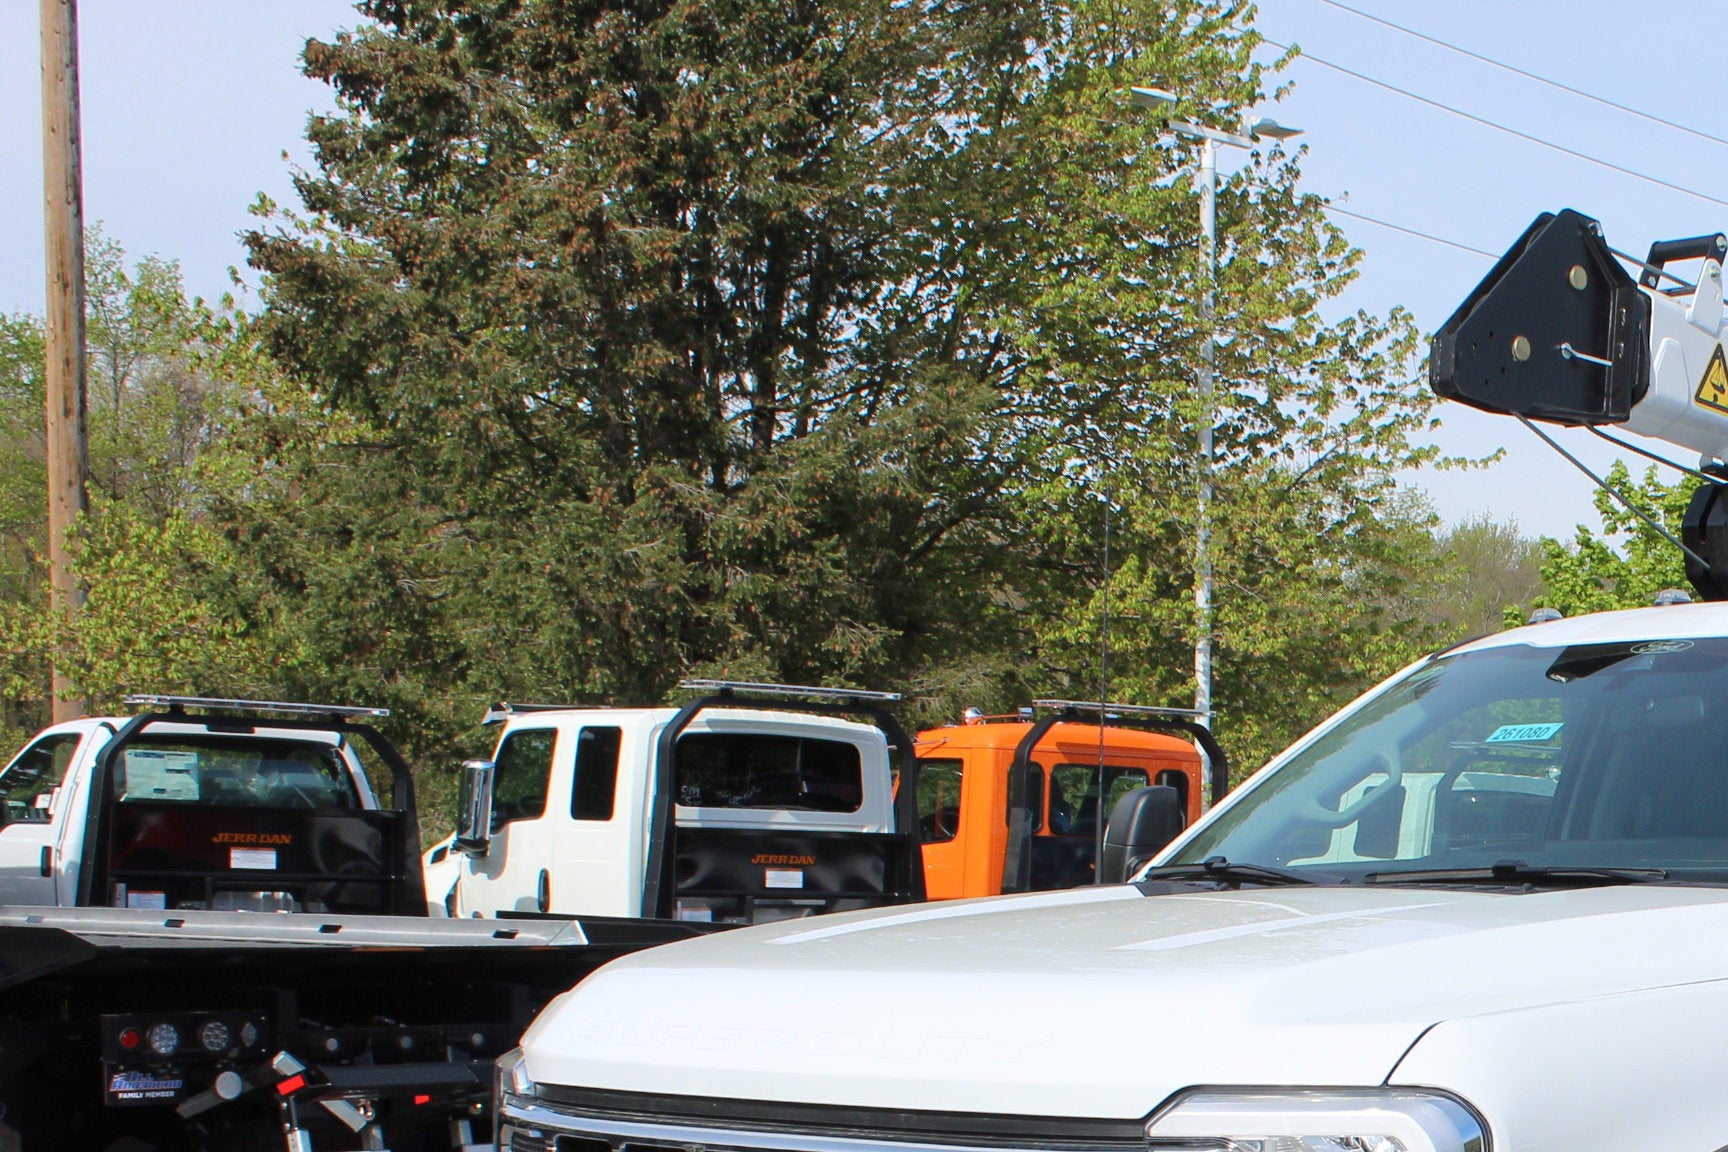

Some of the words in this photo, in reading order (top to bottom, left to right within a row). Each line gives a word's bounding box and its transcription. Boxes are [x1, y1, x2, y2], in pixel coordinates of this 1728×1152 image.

[1493, 727, 1550, 740] 261080
[752, 854, 816, 865] JERR-DAN
[573, 1016, 799, 1058] SUPER
